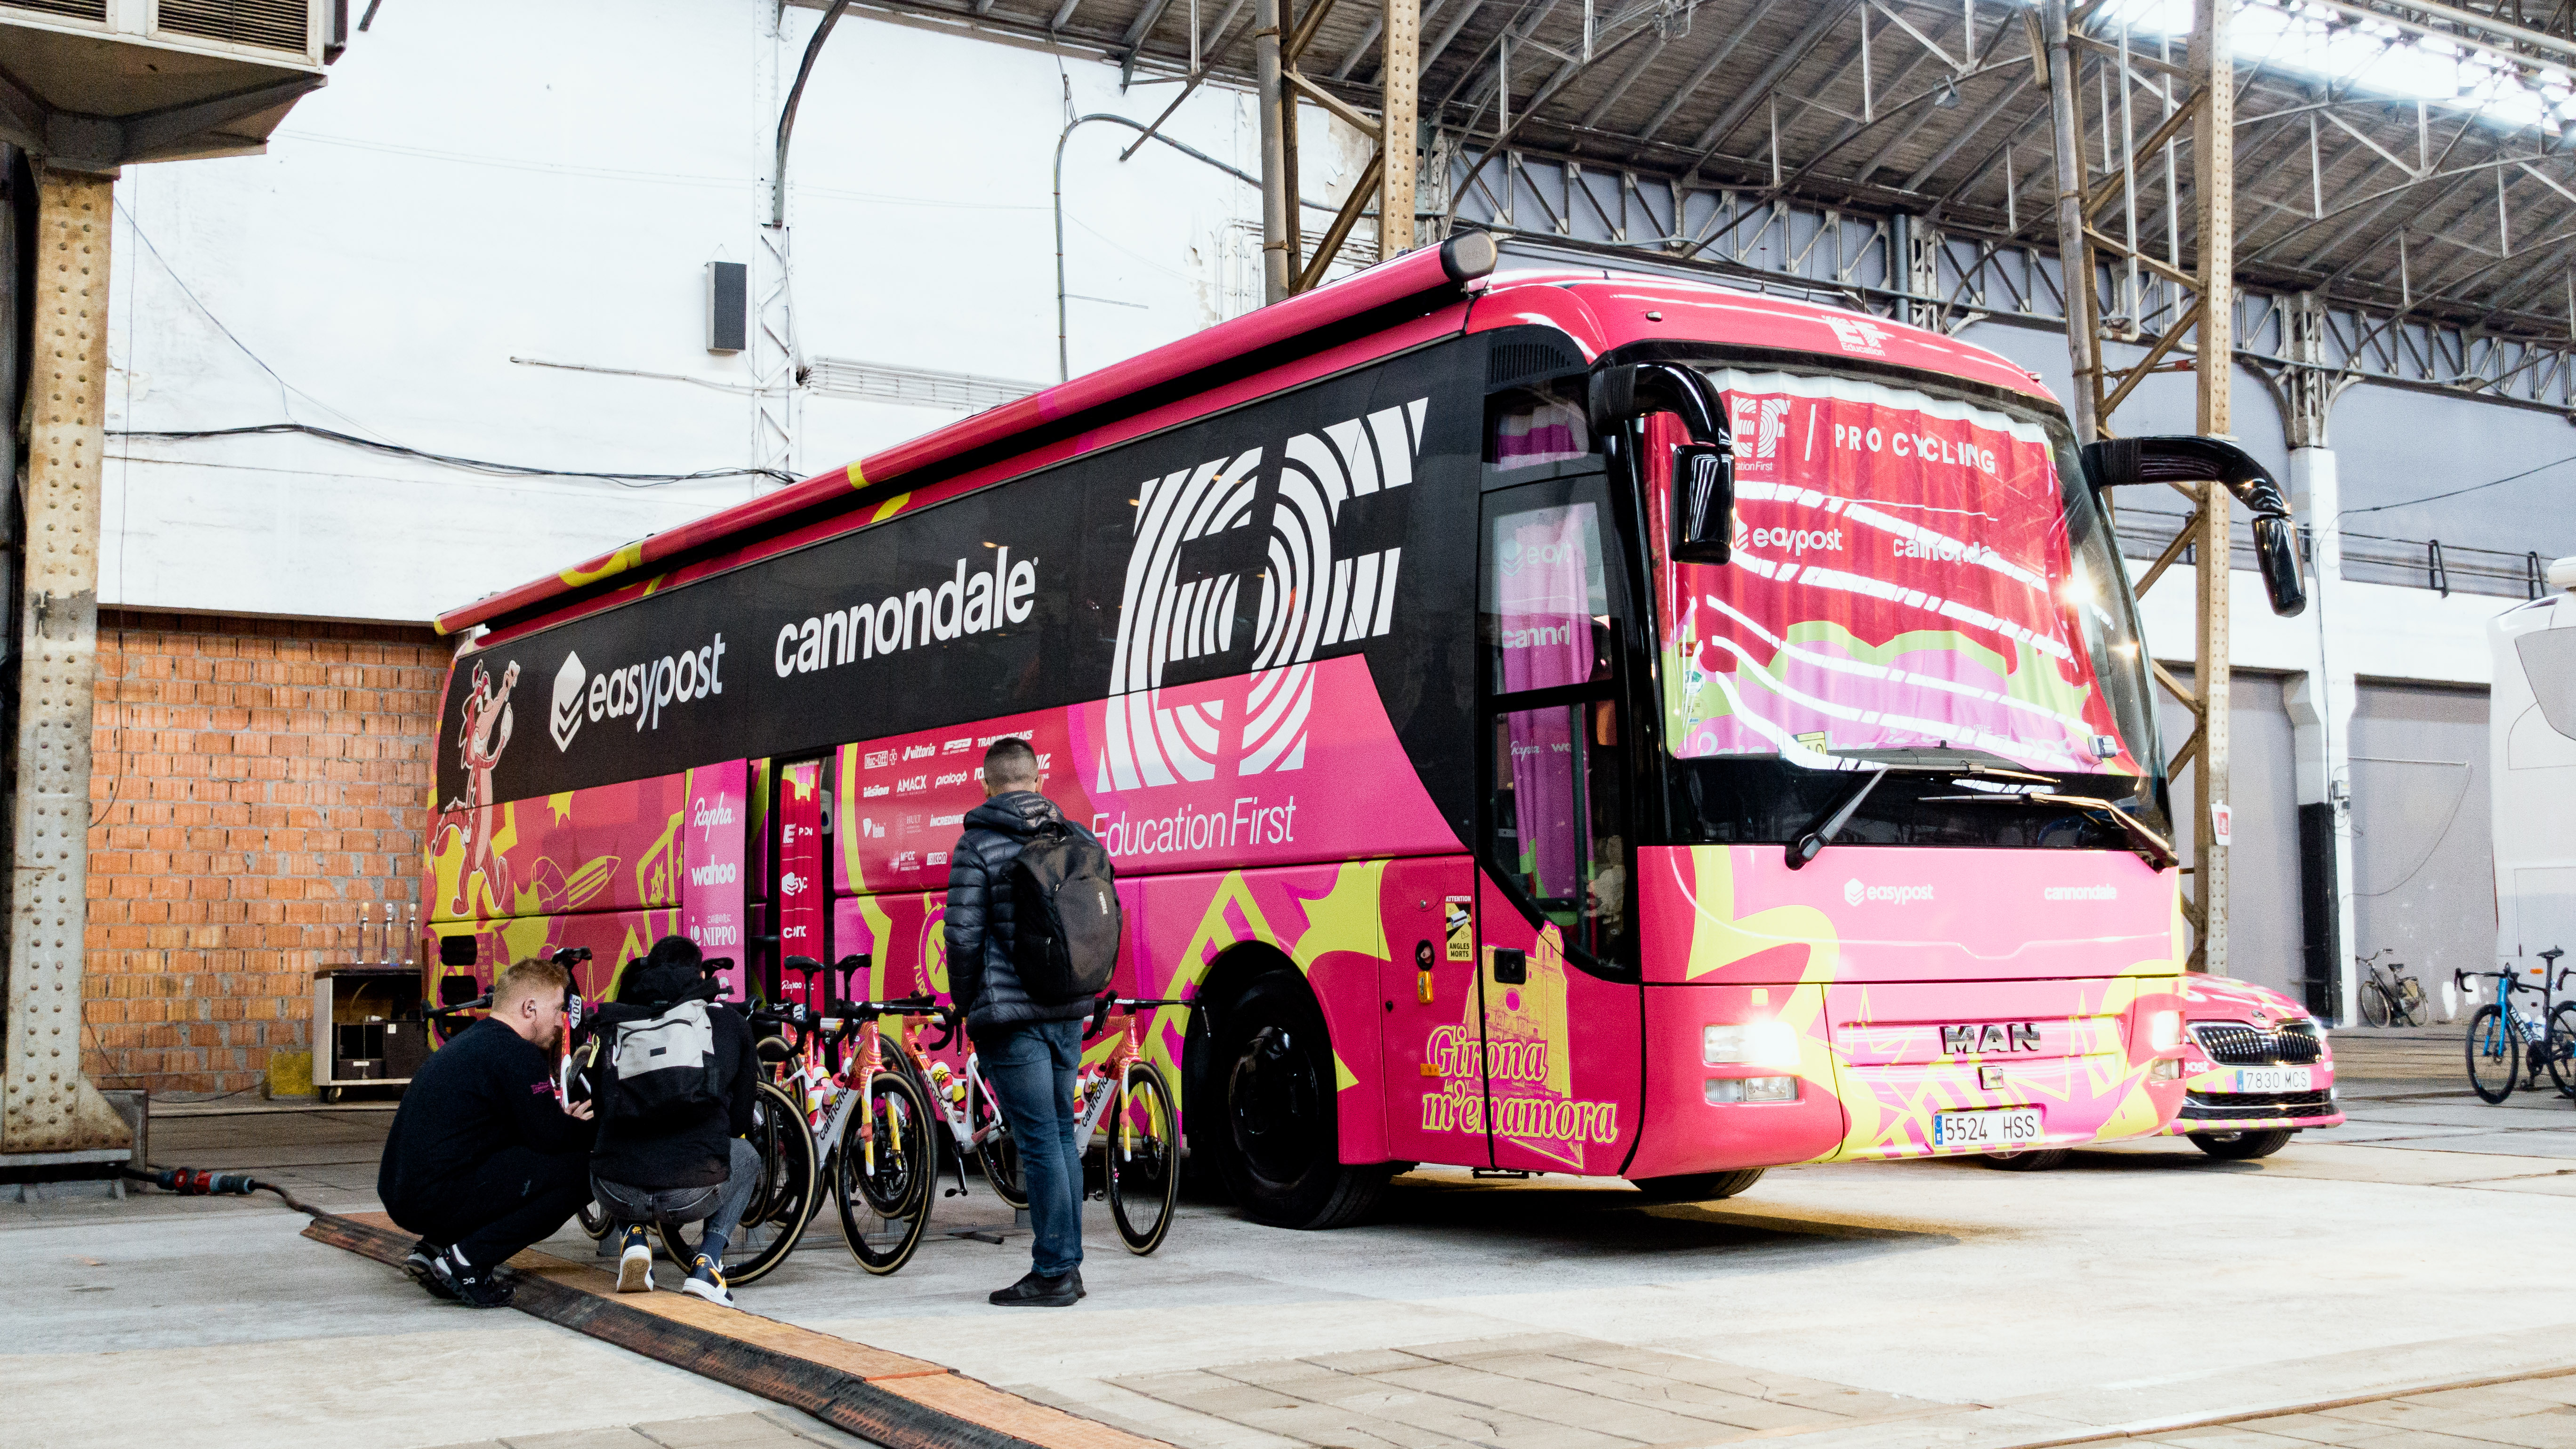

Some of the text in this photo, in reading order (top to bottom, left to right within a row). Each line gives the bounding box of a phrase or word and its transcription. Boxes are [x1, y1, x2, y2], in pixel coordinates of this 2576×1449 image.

[1841, 342, 1886, 357] Education
[1835, 423, 1882, 452] PRO
[1892, 432, 1996, 474] CYCLING
[1755, 461, 1773, 471] First
[1095, 397, 1428, 793] EF
[775, 546, 1037, 678] cannondale
[588, 632, 726, 733] easypost
[910, 743, 936, 759] vittoria
[896, 775, 927, 793] AMACX
[934, 770, 967, 789] prologo
[693, 791, 733, 842] Rapha
[1092, 796, 1296, 857] Education First
[691, 854, 736, 886] wahoo
[1866, 884, 1934, 905] easypost
[2044, 883, 2117, 901] cannondale
[703, 925, 737, 946] NIPPO
[1940, 1022, 2041, 1055] MAN
[1426, 1025, 1548, 1082] Girona
[2246, 1072, 2280, 1089] 7830
[2285, 1071, 2307, 1087] MCS
[1936, 1115, 2035, 1141] E 5524 HSS
